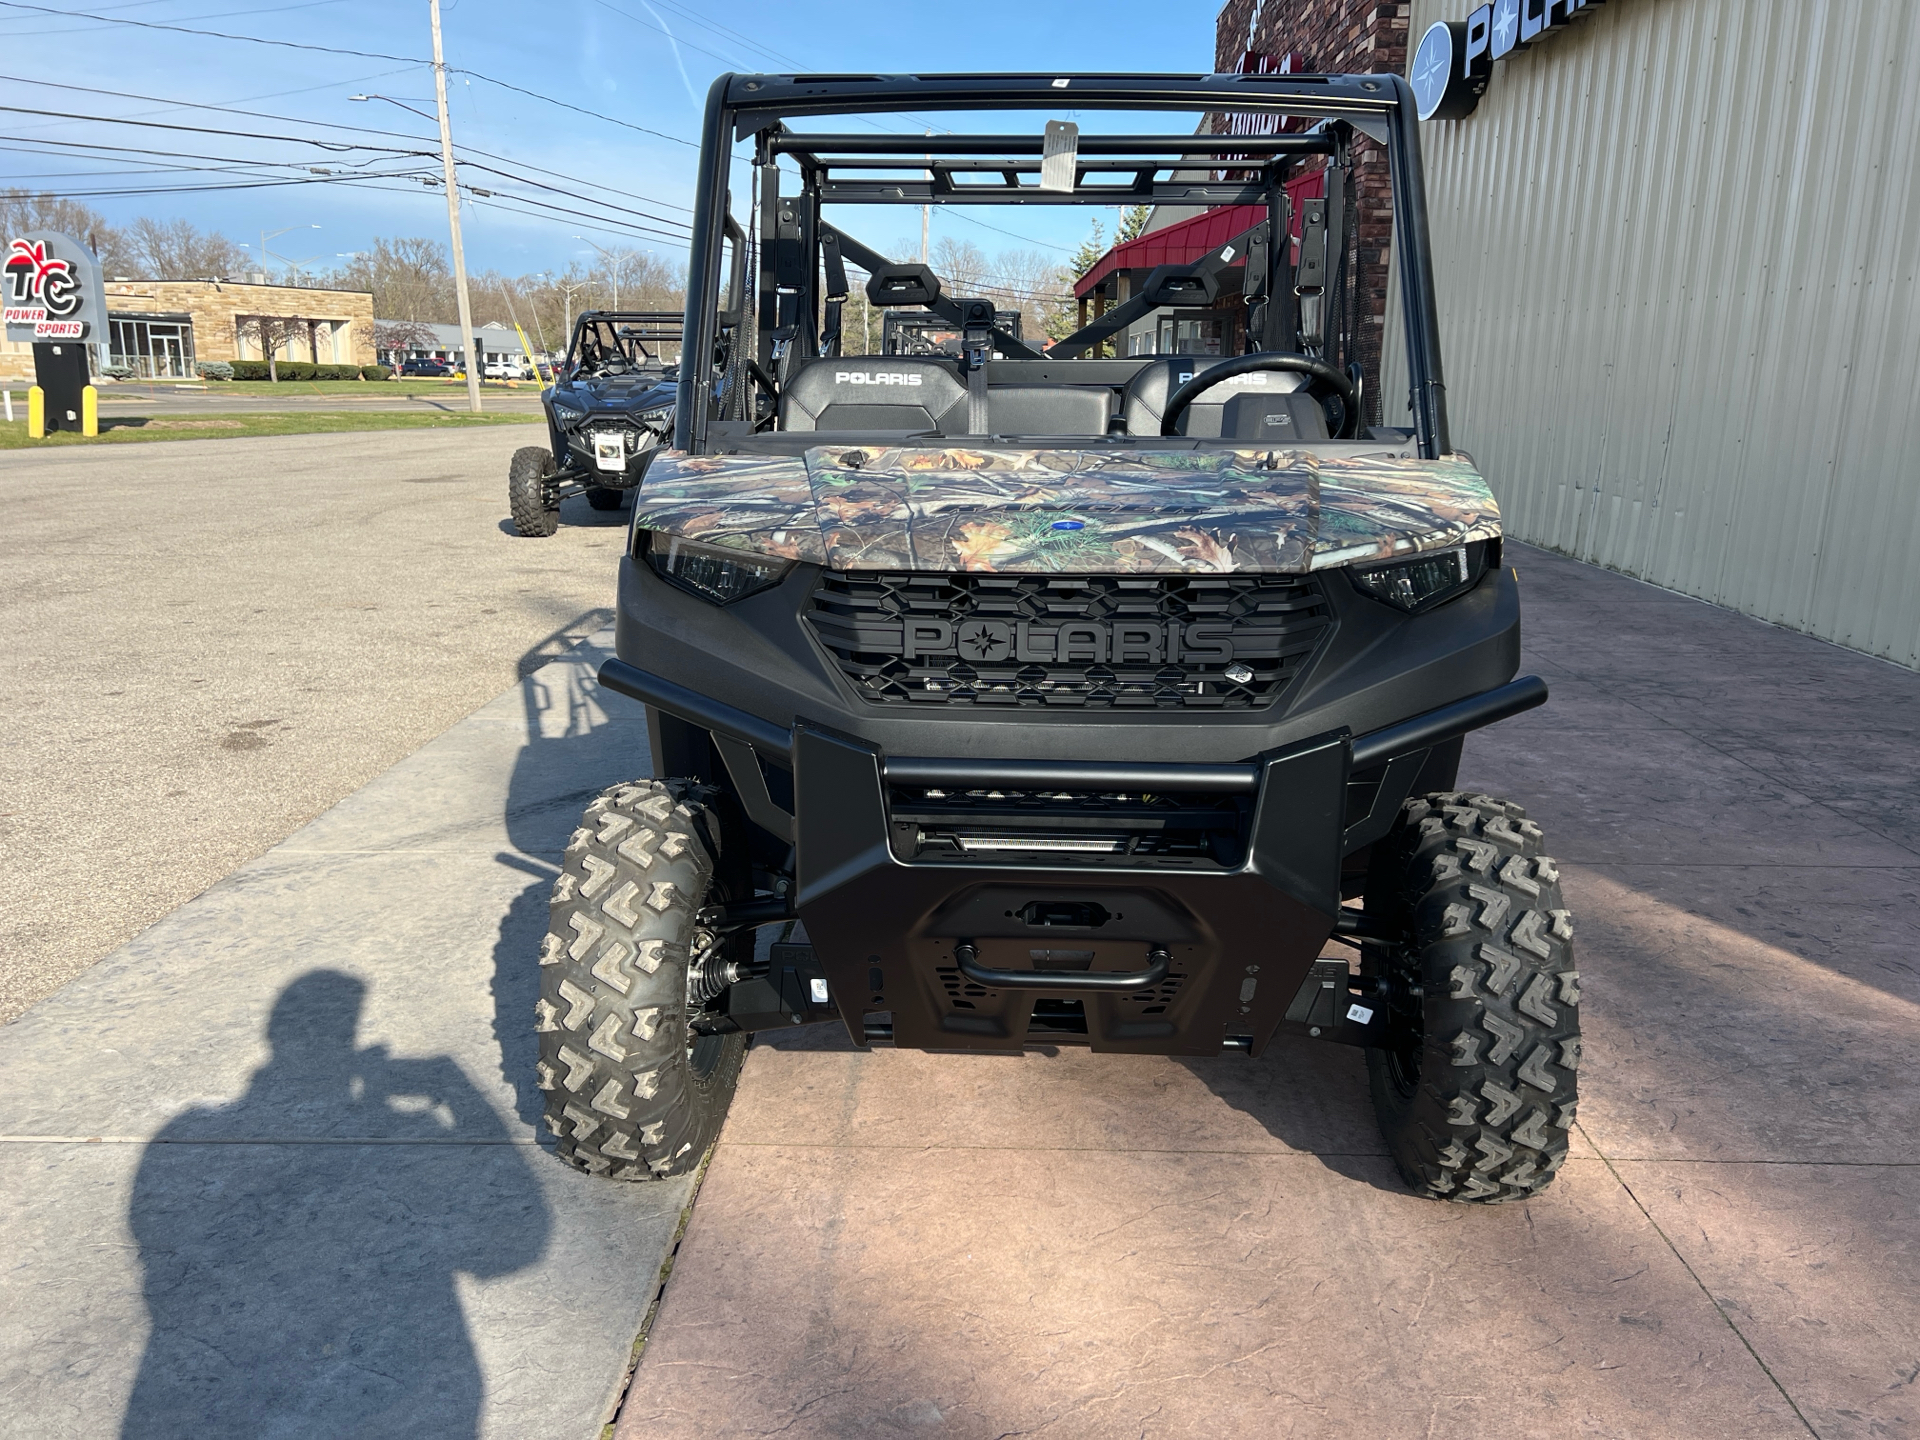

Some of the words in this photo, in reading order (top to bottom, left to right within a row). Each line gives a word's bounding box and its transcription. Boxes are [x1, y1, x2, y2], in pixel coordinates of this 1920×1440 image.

[5, 309, 45, 320] POWER
[36, 323, 81, 334] SPORTS
[835, 372, 923, 386] POLARIS
[902, 618, 1234, 665] POLARIS
